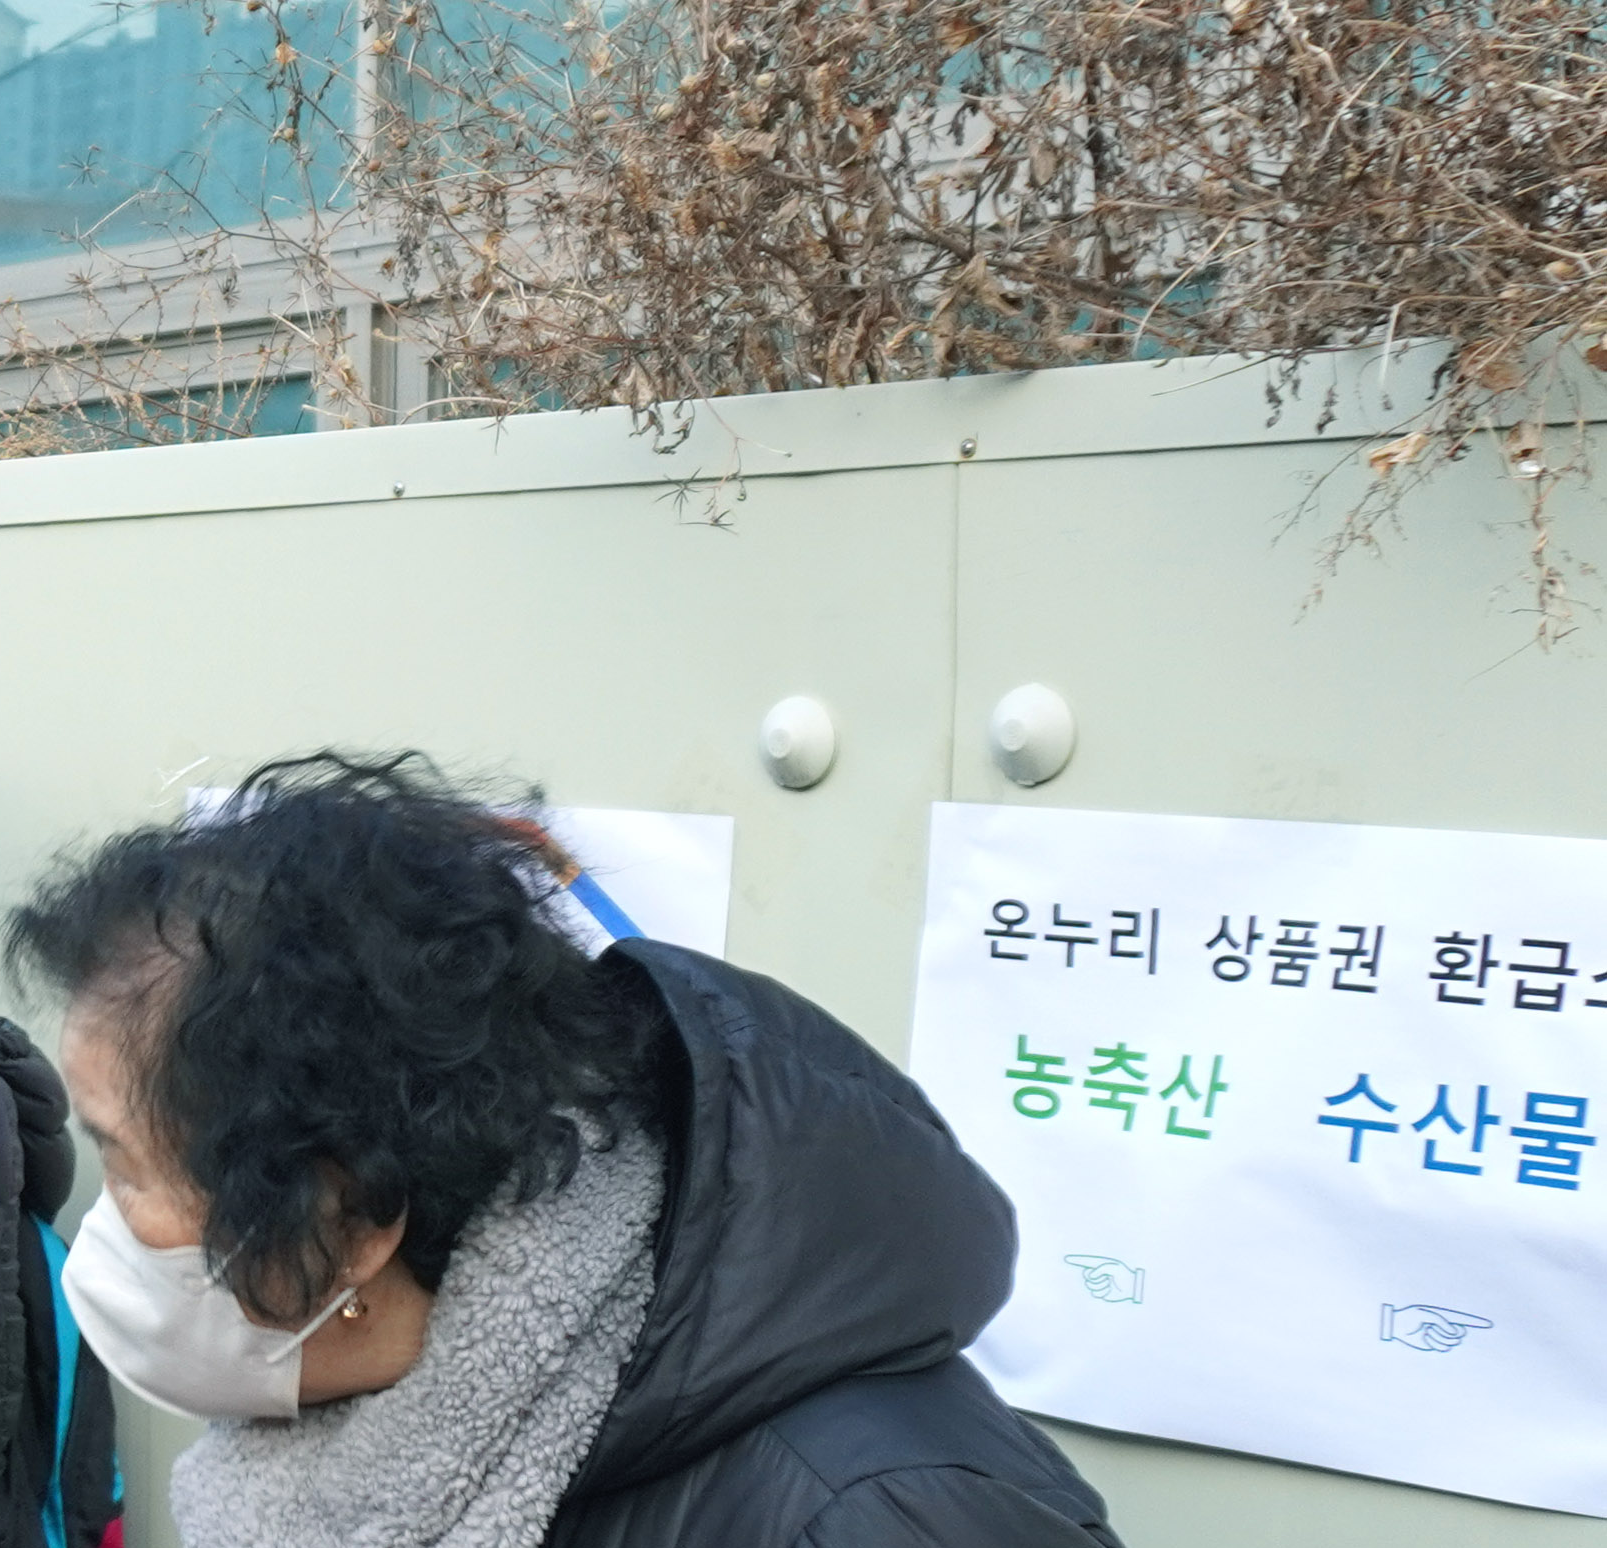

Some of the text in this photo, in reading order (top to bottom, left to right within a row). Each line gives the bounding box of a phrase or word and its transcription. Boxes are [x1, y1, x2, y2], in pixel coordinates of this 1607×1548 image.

[982, 898, 1161, 976] 온누리
[1204, 914, 1386, 994] 상품권
[1005, 1035, 1597, 1192] 농축산 수산물
